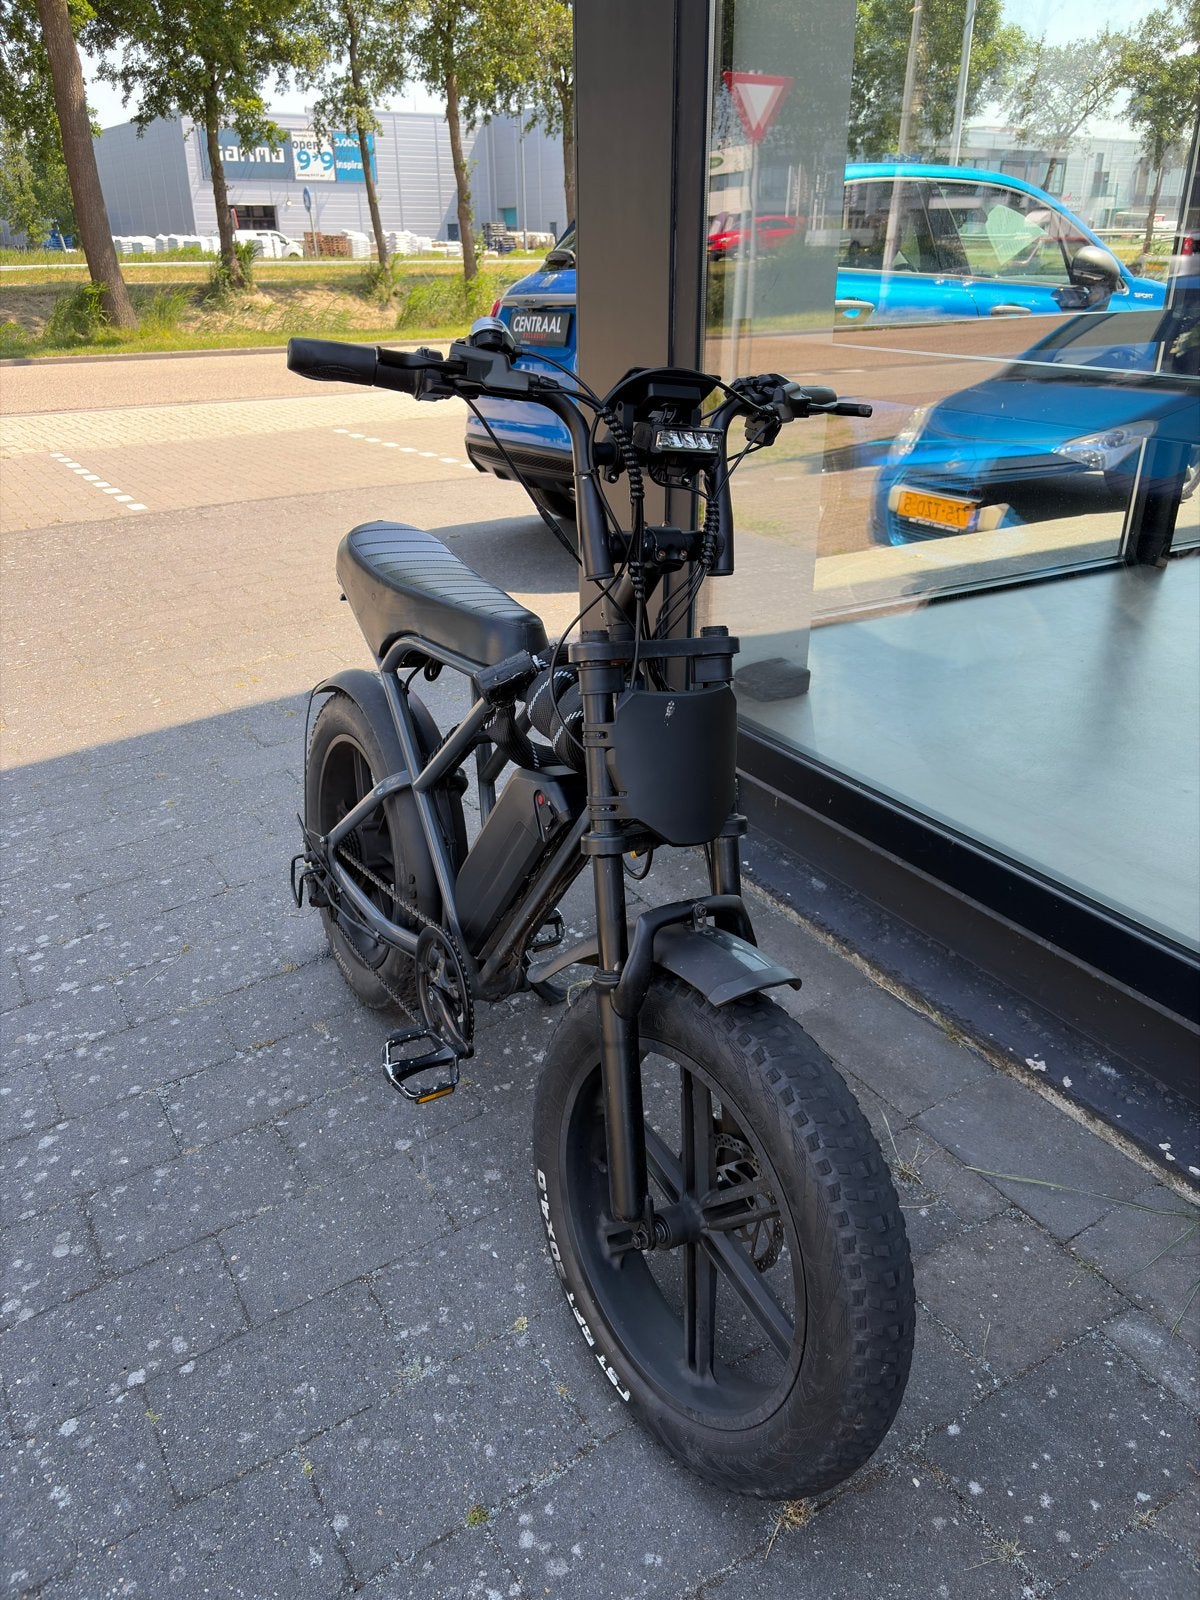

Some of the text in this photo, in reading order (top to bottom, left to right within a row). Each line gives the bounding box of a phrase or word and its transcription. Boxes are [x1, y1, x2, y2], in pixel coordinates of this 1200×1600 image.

[292, 140, 319, 150] open
[336, 160, 364, 170] inspira
[513, 316, 561, 333] CENTRAAL
